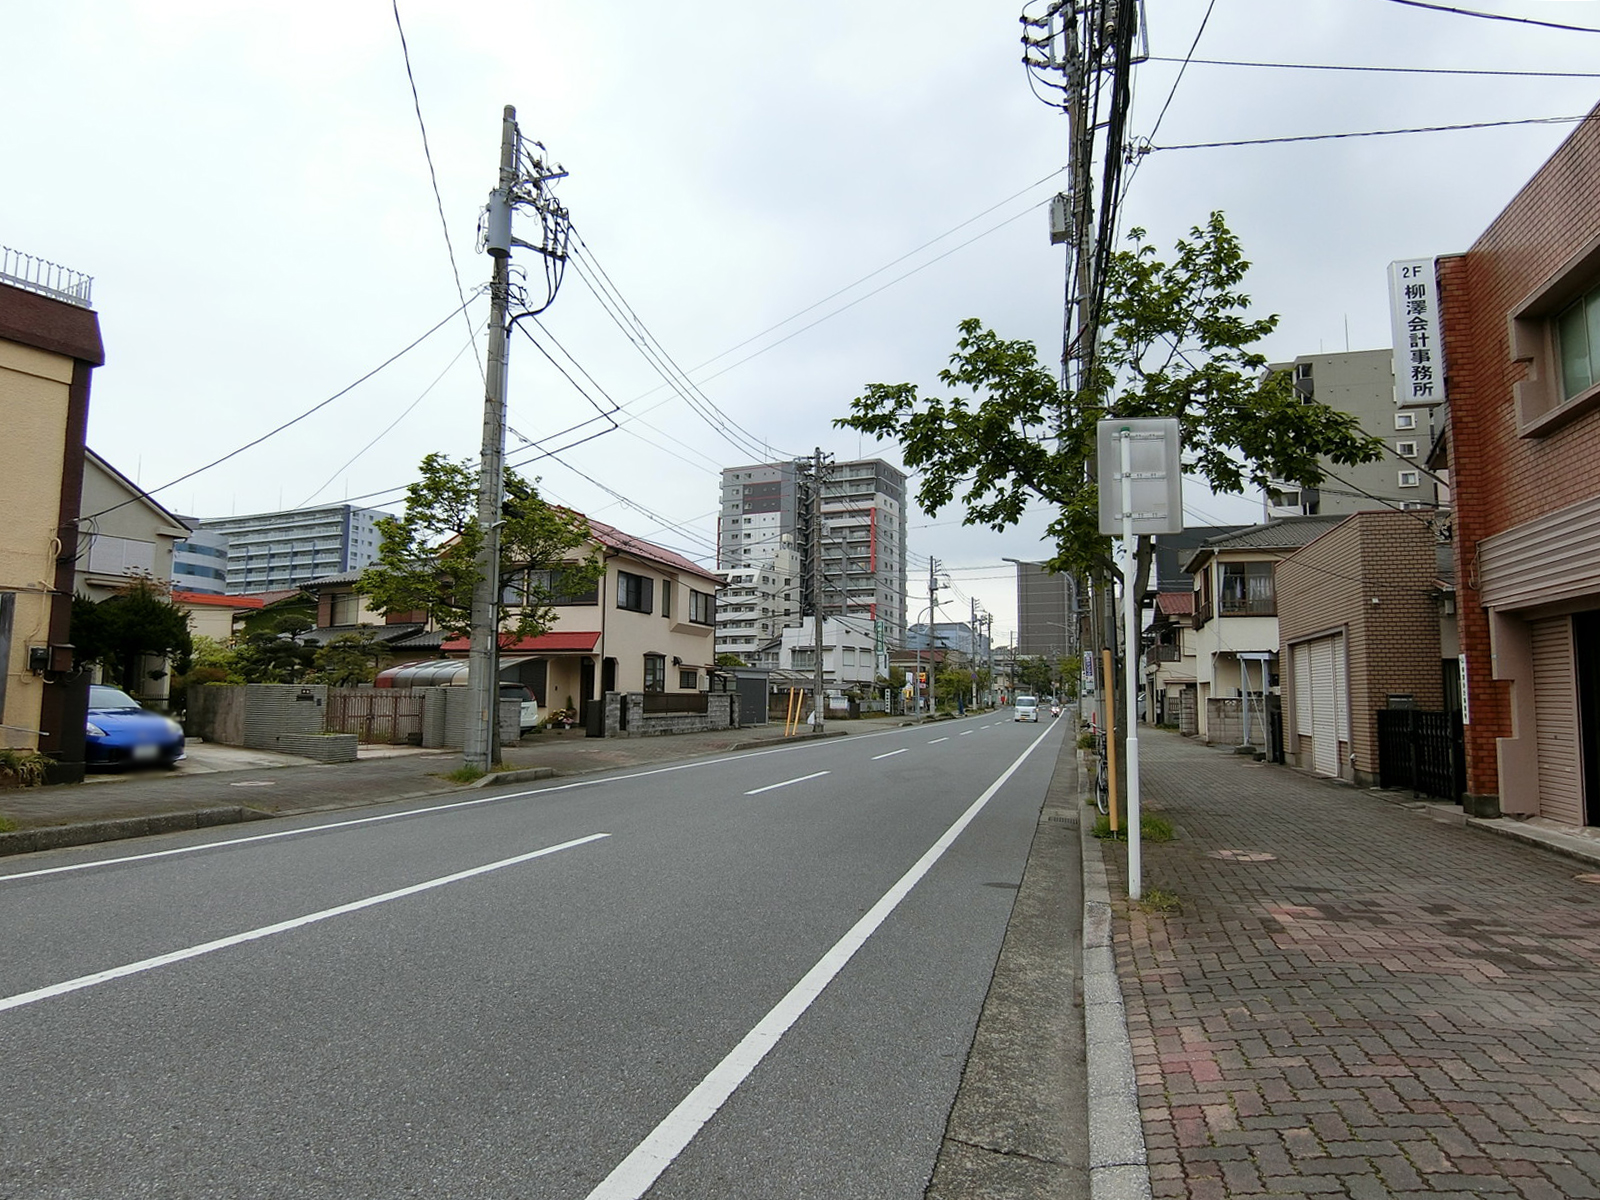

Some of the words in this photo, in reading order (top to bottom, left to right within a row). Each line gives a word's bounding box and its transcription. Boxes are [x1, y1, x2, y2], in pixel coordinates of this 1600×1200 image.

[1402, 266, 1422, 279] 2F
[1404, 284, 1434, 397] 柳澤会計事務所
